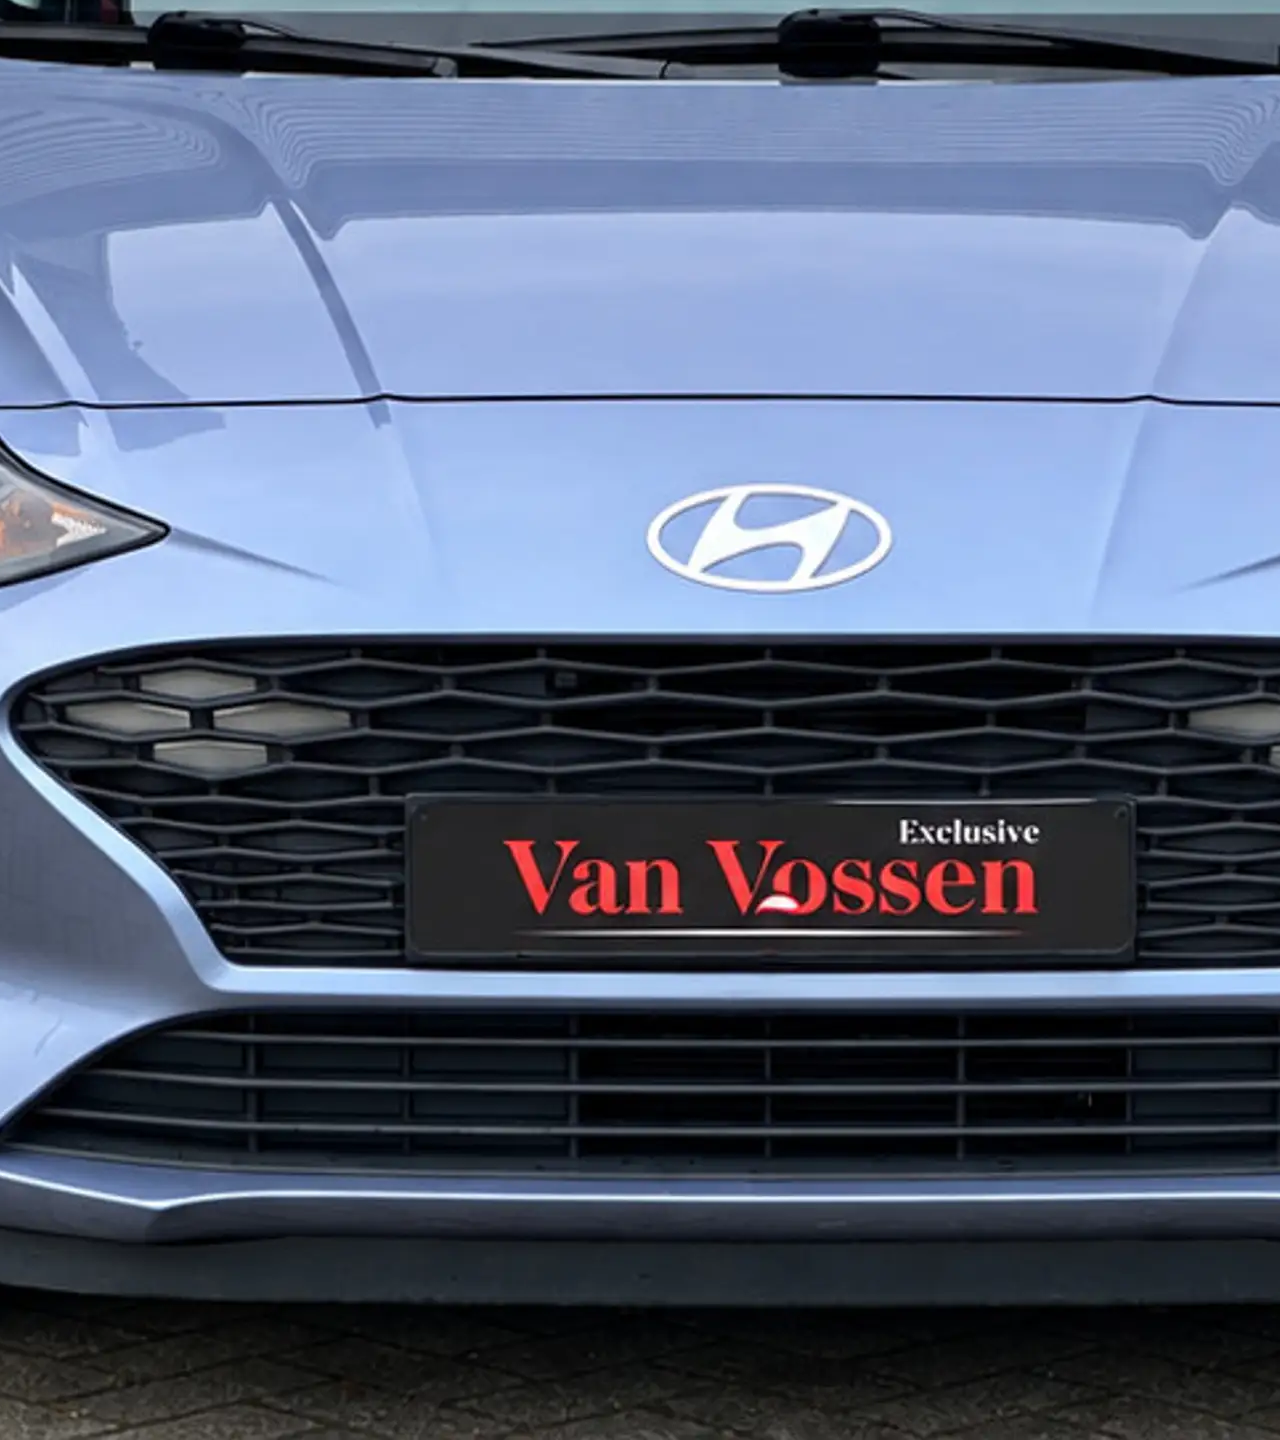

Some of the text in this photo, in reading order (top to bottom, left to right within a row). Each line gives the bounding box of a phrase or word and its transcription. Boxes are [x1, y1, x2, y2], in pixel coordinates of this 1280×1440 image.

[899, 818, 1040, 845] Exclusive
[503, 839, 1040, 916] Van Vossen
